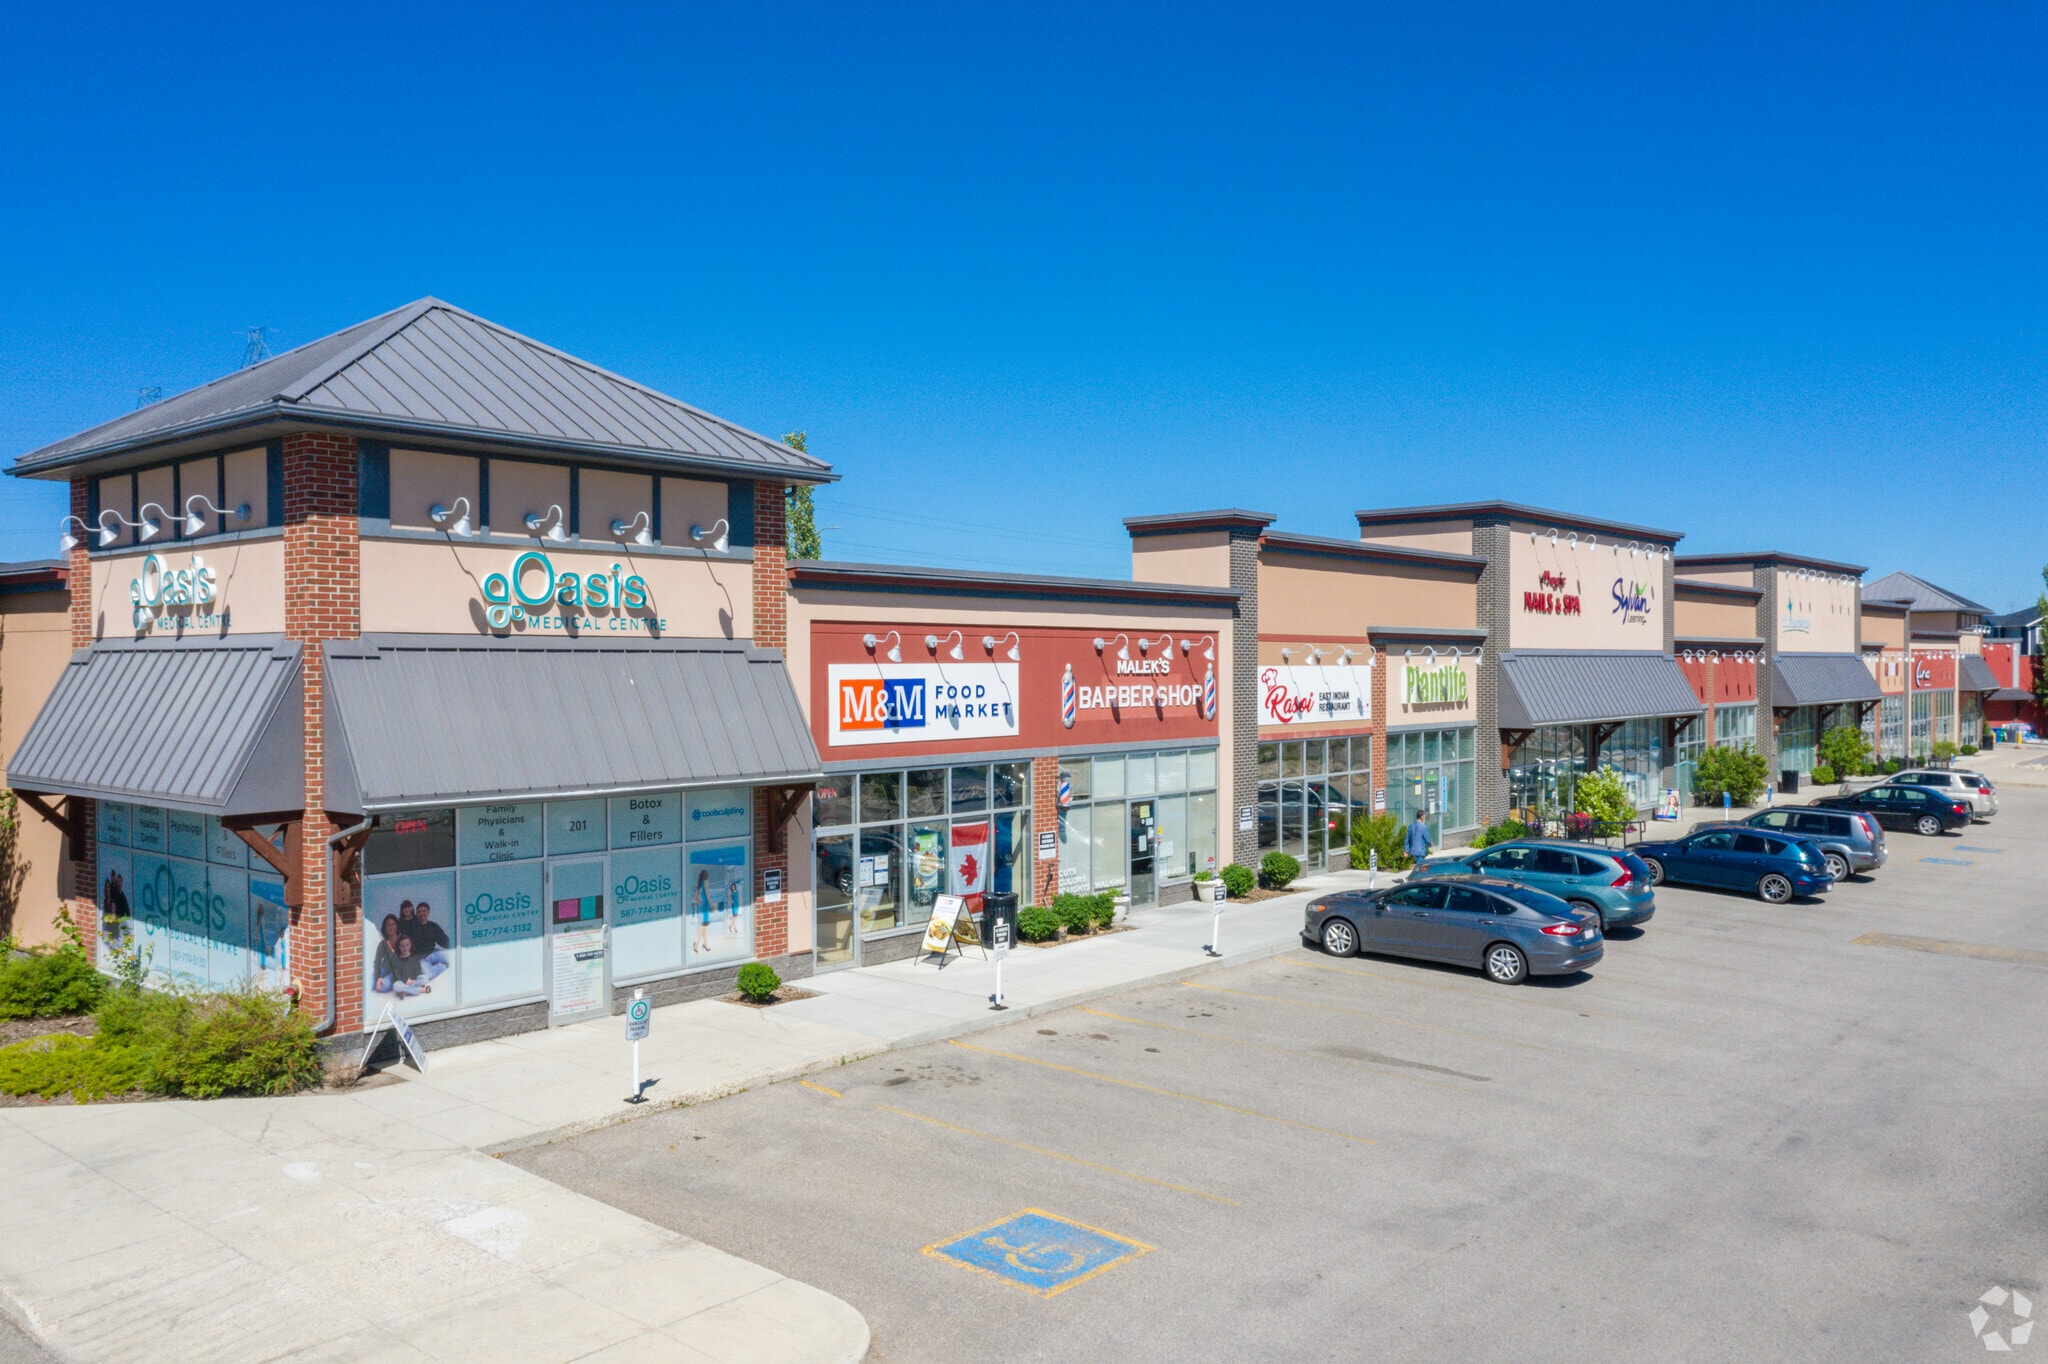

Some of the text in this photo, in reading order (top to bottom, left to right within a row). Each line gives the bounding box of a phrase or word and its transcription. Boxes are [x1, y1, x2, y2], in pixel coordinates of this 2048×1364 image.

[1524, 591, 1581, 616] NAILS & SPA
[1612, 578, 1650, 625] Sylvan
[157, 613, 232, 630] MEDICAL CENTRE
[528, 616, 667, 631] MEDICAL CENTRE
[1117, 657, 1171, 674] MALEK'S
[1403, 665, 1467, 703] Plantlife
[935, 684, 986, 700] FOOD
[1079, 684, 1203, 709] BARBER SHOP
[1319, 691, 1350, 701] EAST INDIAN
[842, 685, 923, 723] M&M
[935, 702, 1012, 720] MARKET
[1265, 685, 1315, 723] Rasoi
[1319, 702, 1351, 712] RESTAURANT
[817, 786, 838, 800] OPEN
[486, 804, 517, 814] Family
[630, 799, 663, 810] Botox
[701, 806, 745, 818] coolsculpting
[478, 815, 525, 827] Physicians
[570, 820, 587, 832] 201
[642, 814, 650, 825] &
[395, 819, 427, 835] OPEN
[498, 828, 505, 837] &
[630, 830, 663, 842] Fillers
[485, 839, 519, 850] Walk-in
[489, 851, 515, 862] Clinic
[621, 904, 672, 918] 587-774-3132
[472, 923, 532, 939] 587-774-3132
